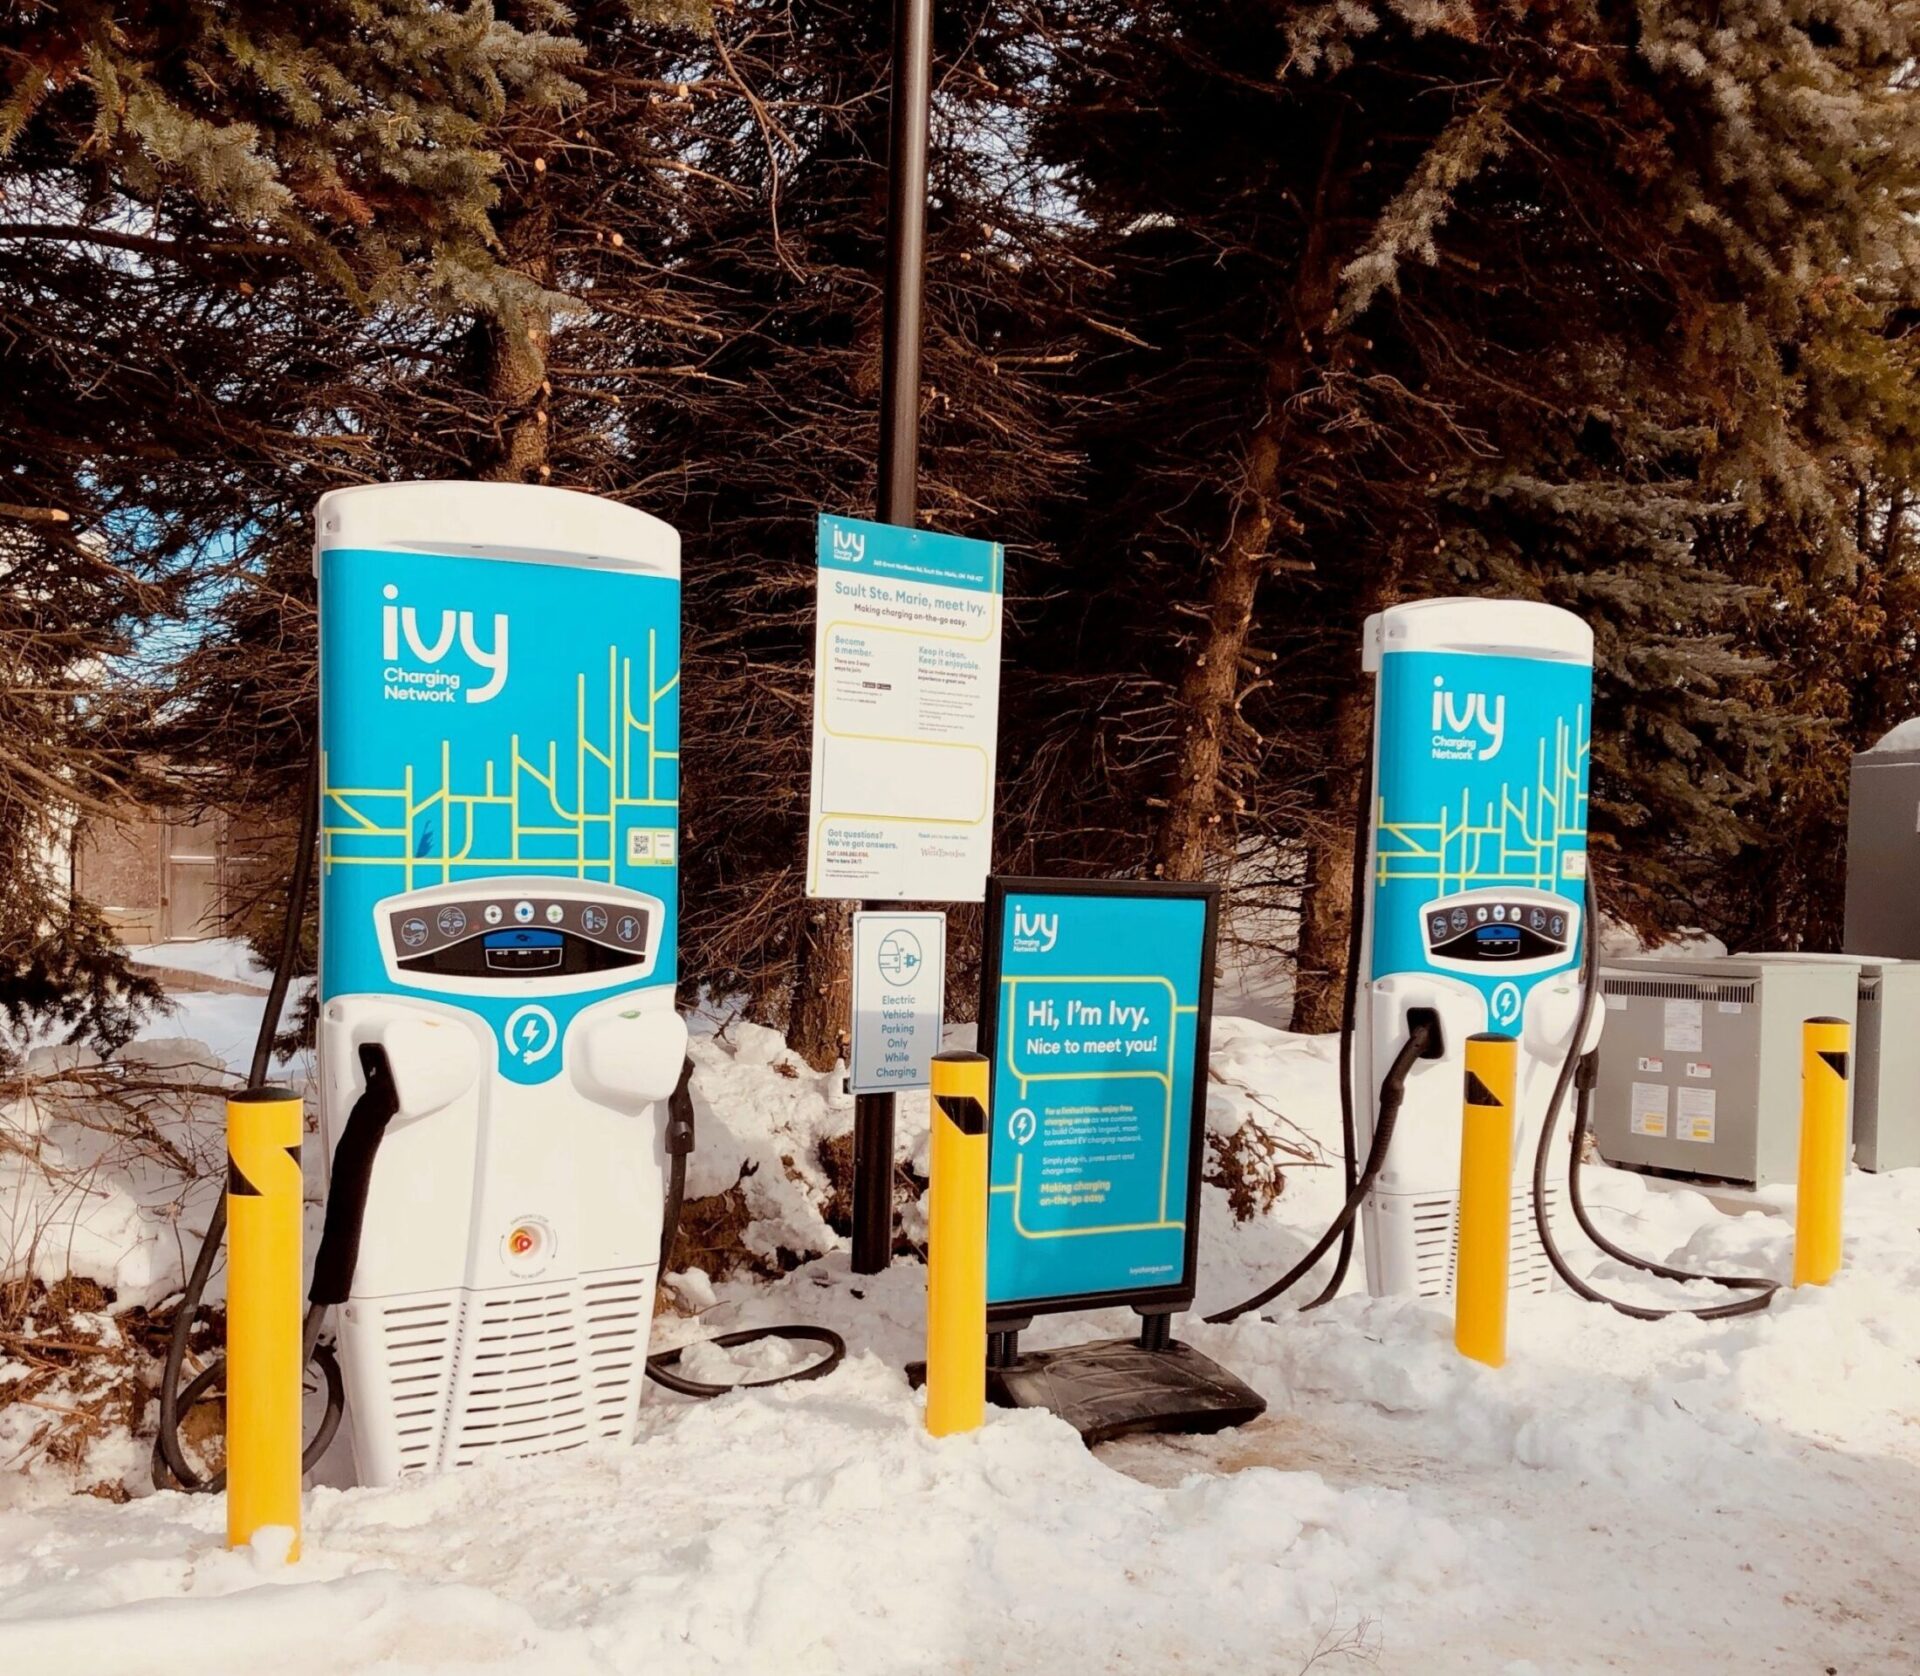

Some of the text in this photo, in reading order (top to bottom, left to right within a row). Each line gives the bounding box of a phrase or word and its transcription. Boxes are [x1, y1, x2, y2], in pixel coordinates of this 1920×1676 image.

[834, 524, 865, 562] ivy
[835, 581, 986, 617] Sault Ste. Marie, meet Ivy.
[854, 603, 968, 627] Making charging on-the-go easy.
[383, 584, 508, 704] ivy
[835, 635, 865, 646] Become
[918, 646, 937, 656] Keep
[938, 648, 944, 656] it
[918, 656, 937, 666] Keep
[938, 658, 944, 666] it
[384, 667, 460, 689] Charging
[384, 685, 456, 703] Network
[1432, 676, 1505, 760] ivy
[1432, 735, 1476, 751] Charging
[1432, 748, 1473, 760] Network
[828, 828, 884, 840] Got questions?
[827, 838, 898, 850] We've got answers.
[1014, 904, 1058, 952] ivy
[882, 995, 916, 1005] Electric
[882, 1010, 915, 1020] Vehicle
[1028, 999, 1150, 1032] Hi, I'm Ivy.
[882, 1024, 914, 1036] Parking
[887, 1038, 908, 1050] Only
[1026, 1035, 1158, 1057] Nice to meet you!
[885, 1053, 910, 1063] While
[876, 1067, 917, 1079] Charging
[1052, 1128, 1068, 1136] build
[1044, 1138, 1078, 1146] connected
[1078, 1136, 1087, 1144] EV
[1042, 1156, 1062, 1166] Simply
[1042, 1168, 1064, 1176] charge
[1040, 1180, 1111, 1194] Making charging
[1040, 1195, 1082, 1206] on-the-go
